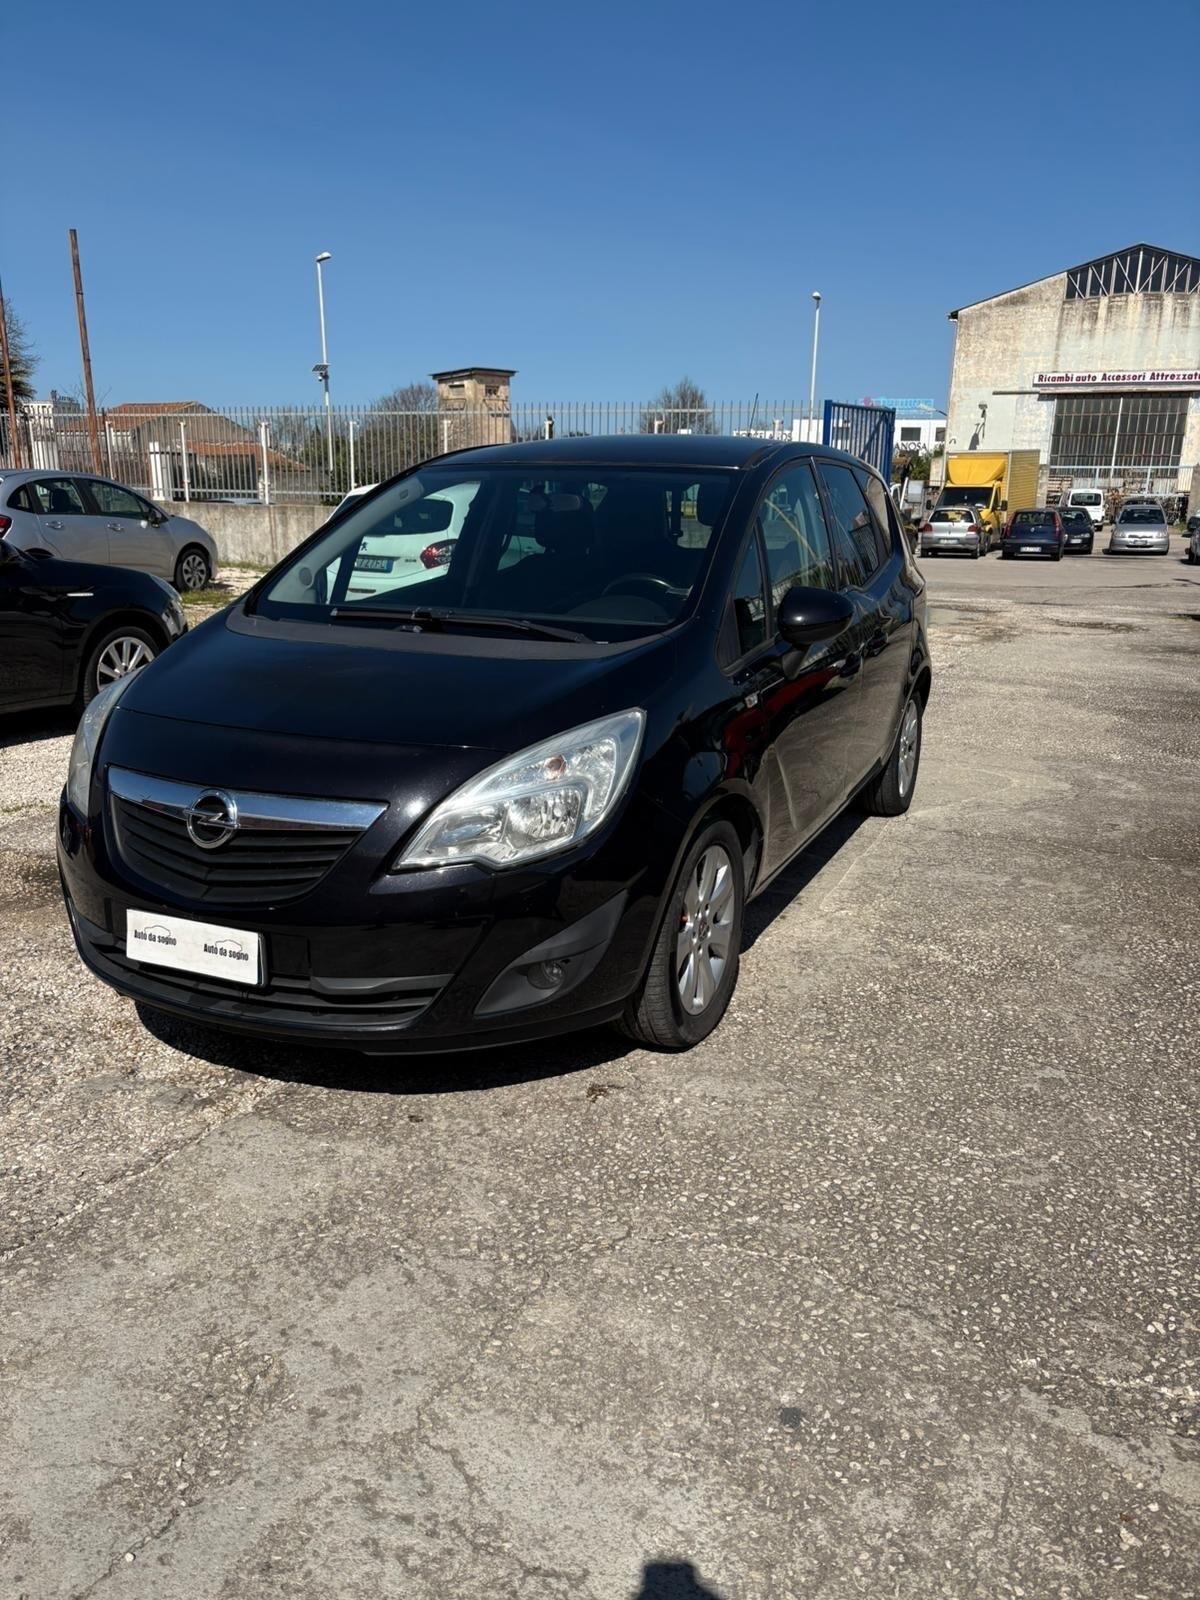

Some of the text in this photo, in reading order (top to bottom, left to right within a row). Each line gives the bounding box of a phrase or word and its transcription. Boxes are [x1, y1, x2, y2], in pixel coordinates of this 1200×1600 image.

[1038, 373, 1073, 382] Ricambi
[1075, 374, 1097, 382] auto
[1101, 372, 1146, 382] Accessori
[134, 929, 177, 946] Auto da sogno
[203, 943, 249, 962] Auto da sogno
